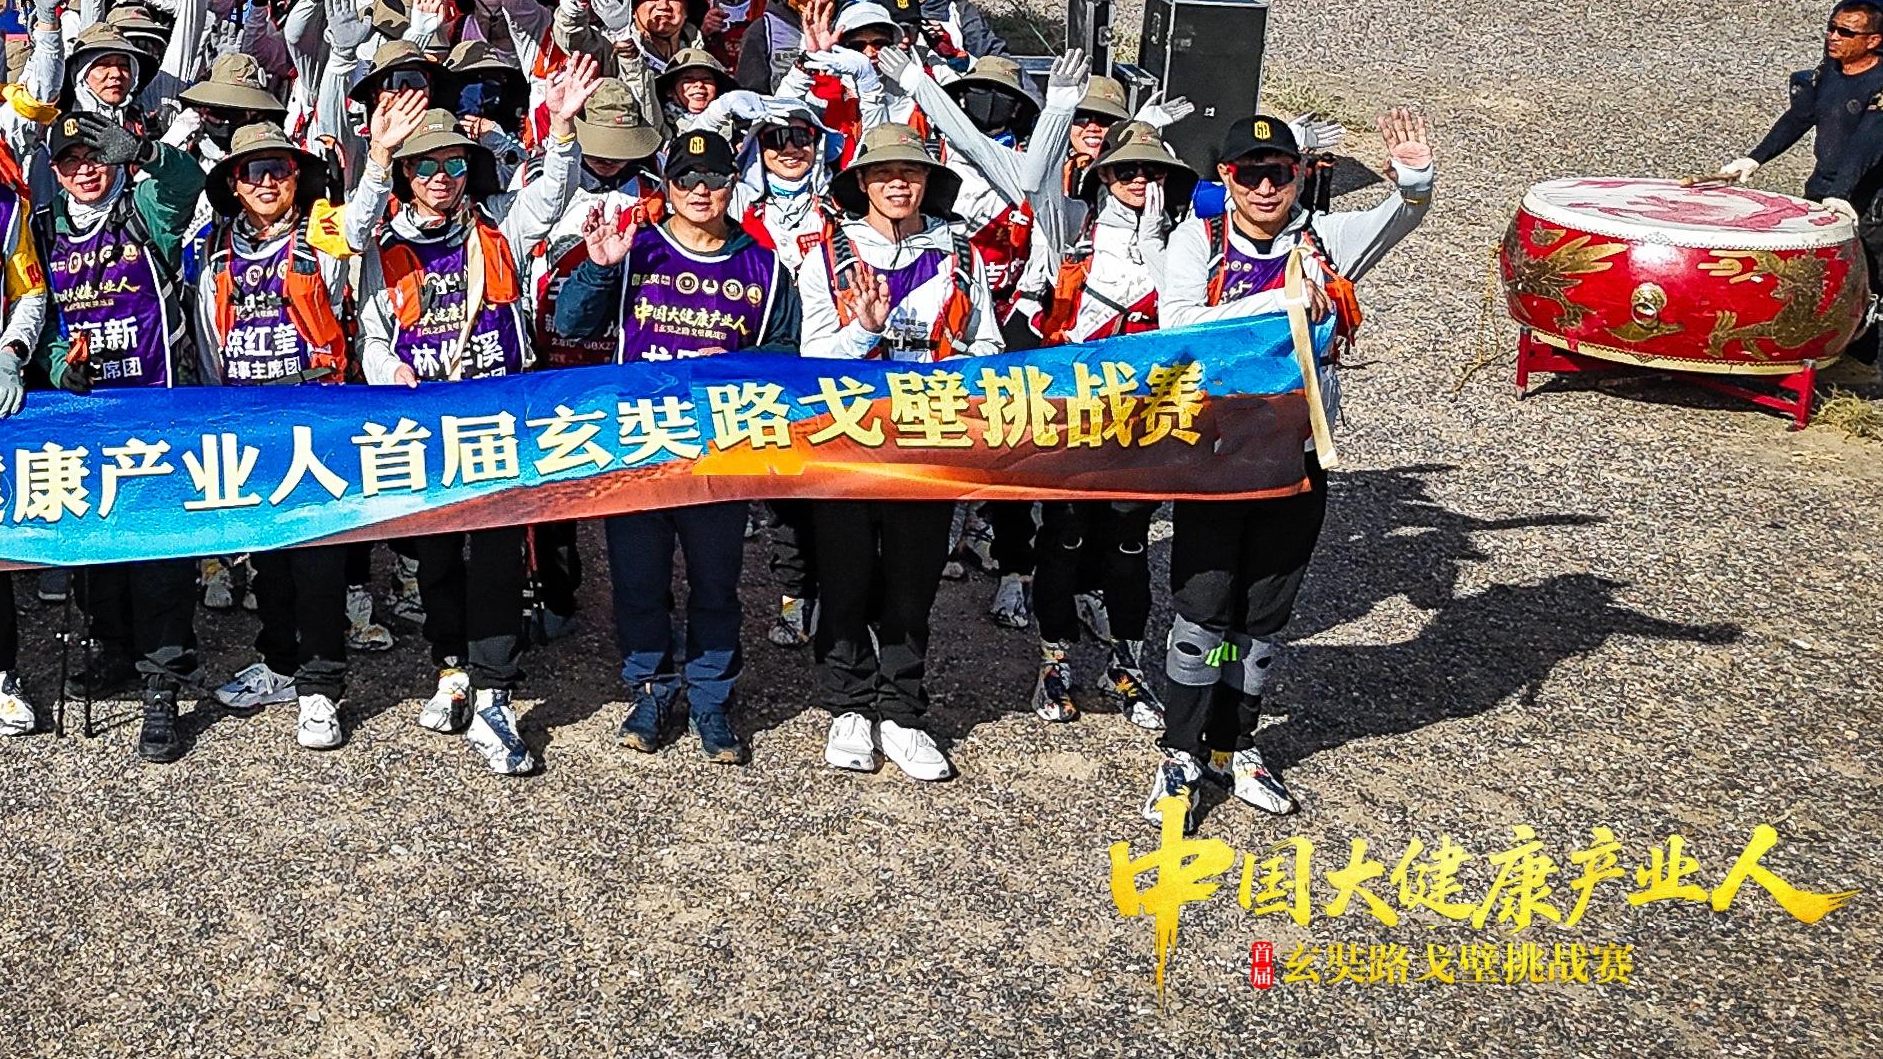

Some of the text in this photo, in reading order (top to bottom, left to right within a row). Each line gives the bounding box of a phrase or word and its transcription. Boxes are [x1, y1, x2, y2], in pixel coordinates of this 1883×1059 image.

[1253, 120, 1272, 140] GB
[633, 296, 751, 337] 中国大健康产业人
